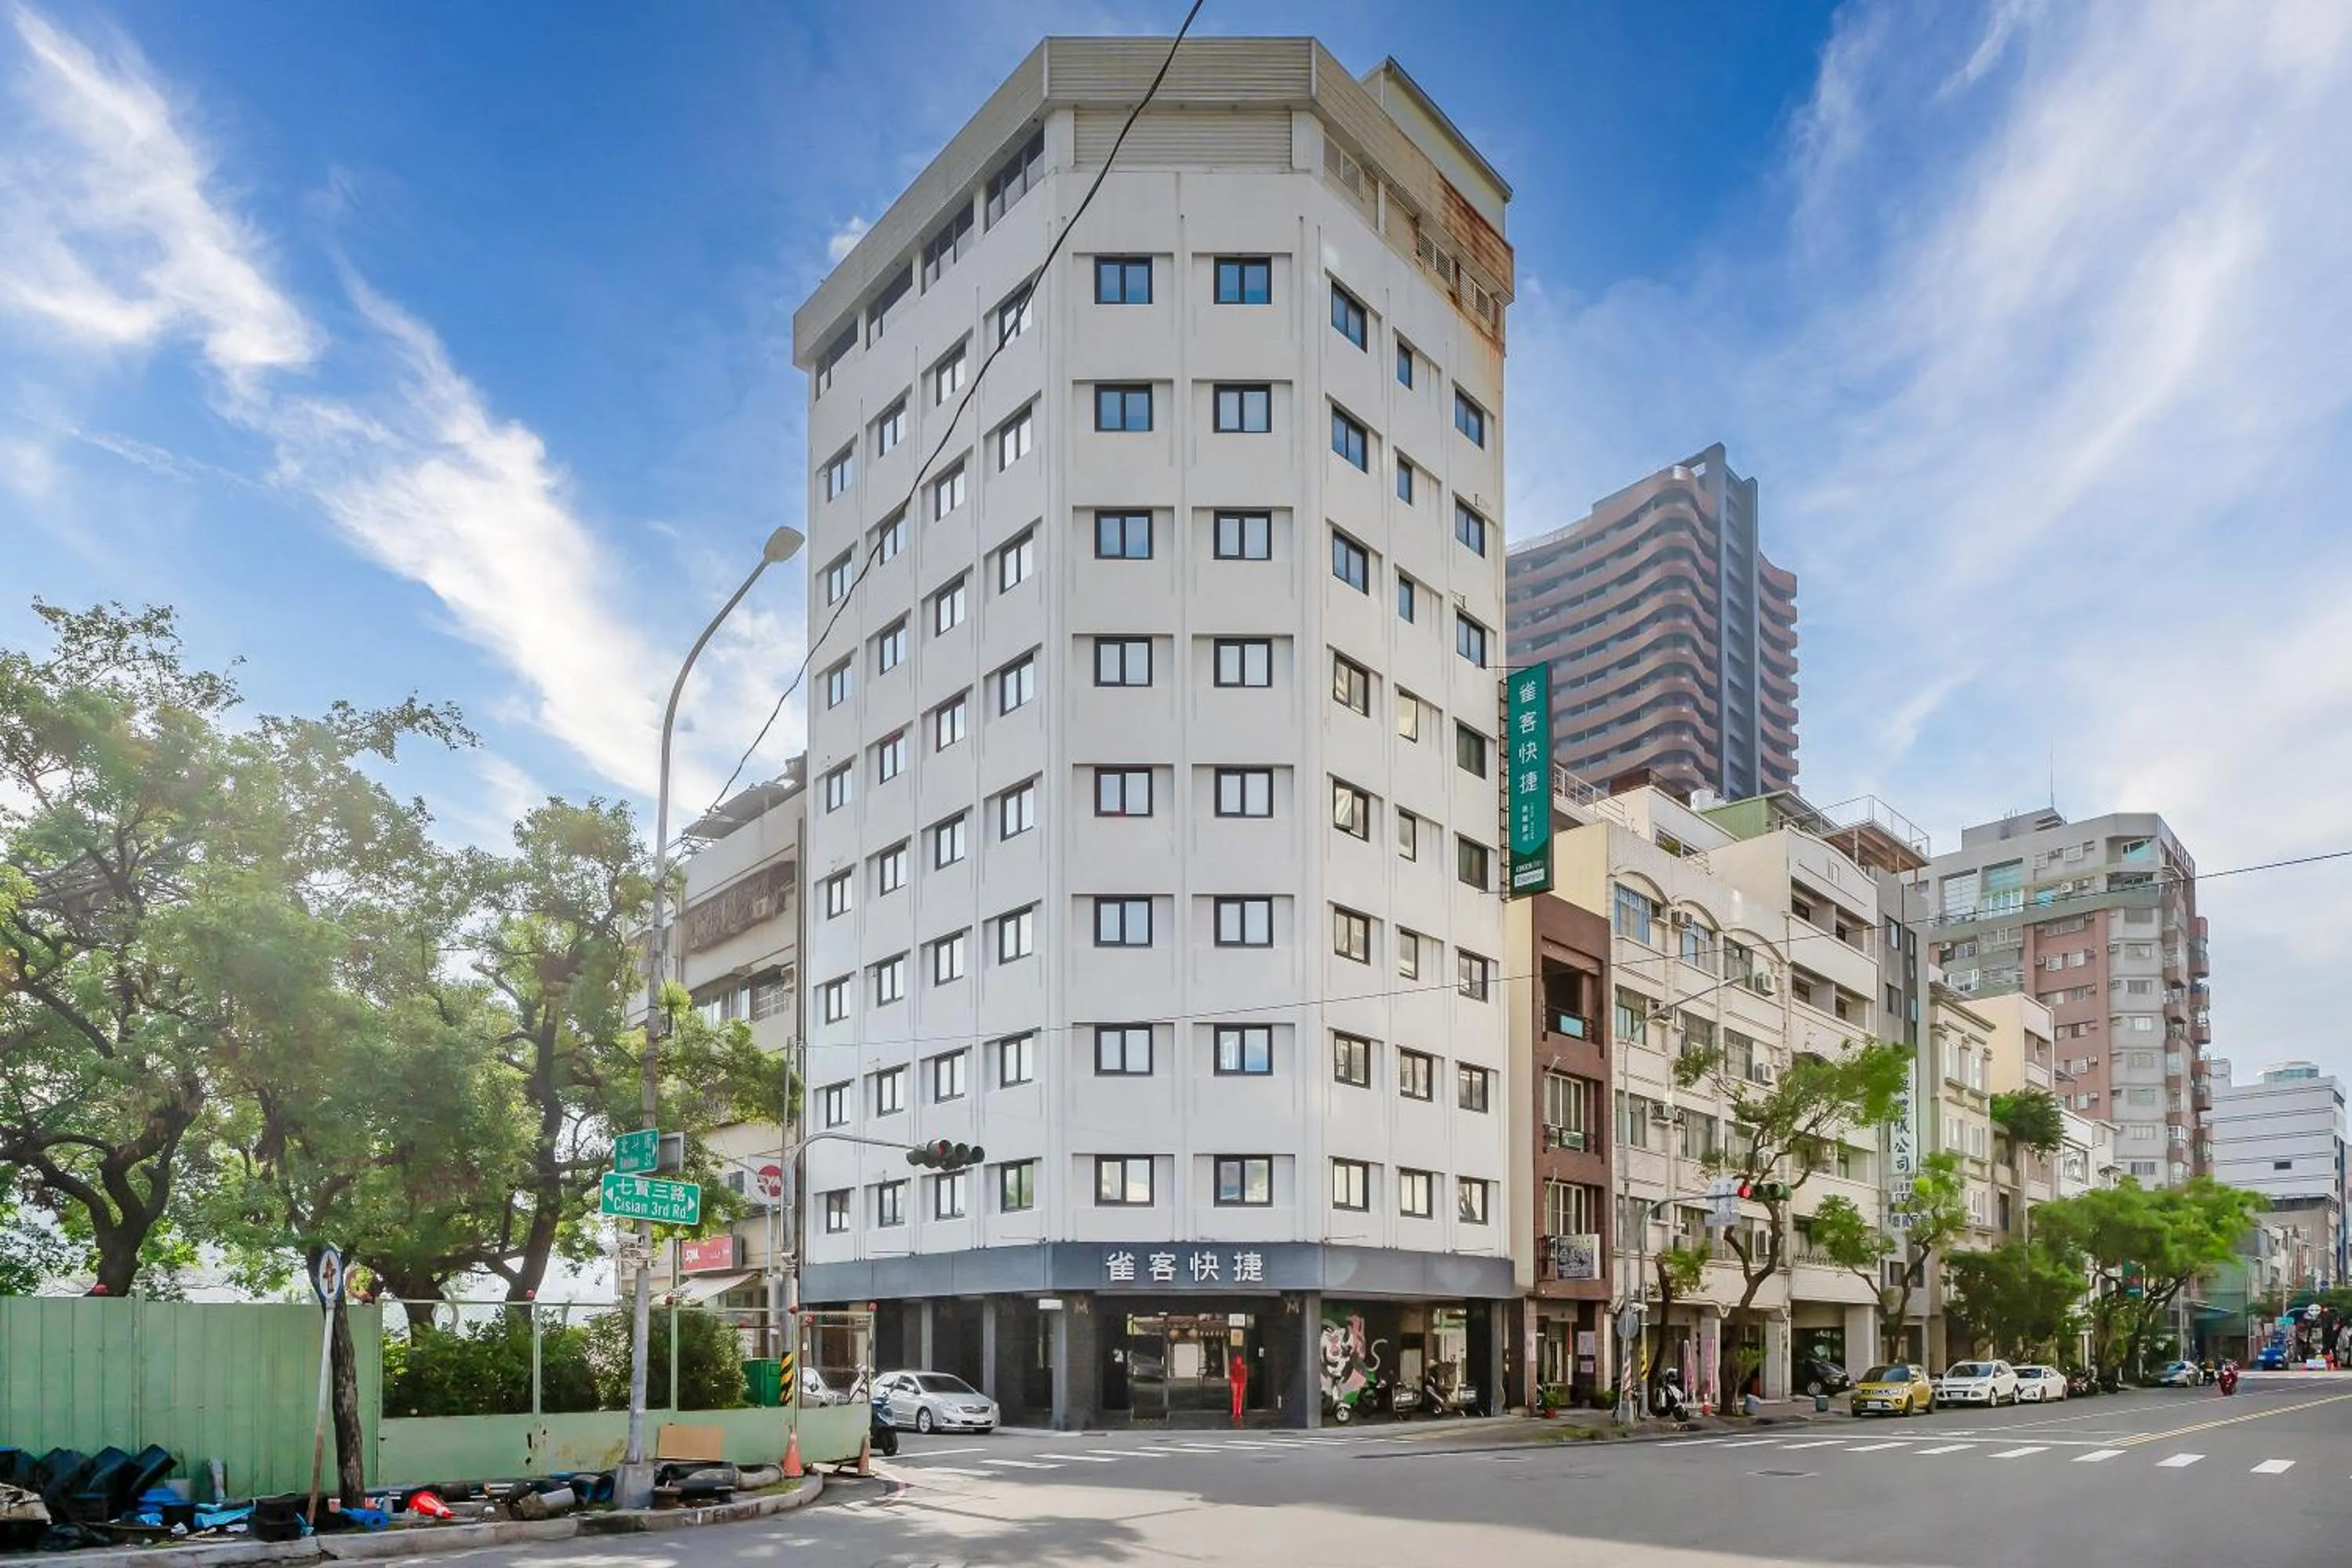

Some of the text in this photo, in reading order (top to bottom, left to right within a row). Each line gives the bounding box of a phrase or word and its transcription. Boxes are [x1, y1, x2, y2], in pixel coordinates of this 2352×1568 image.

[1519, 681, 1538, 794] 雀客快捷
[616, 1178, 686, 1202] 七賢三路
[614, 1196, 689, 1219] Cisian 3rd Rd.
[1105, 1250, 1263, 1282] 雀客快捷
